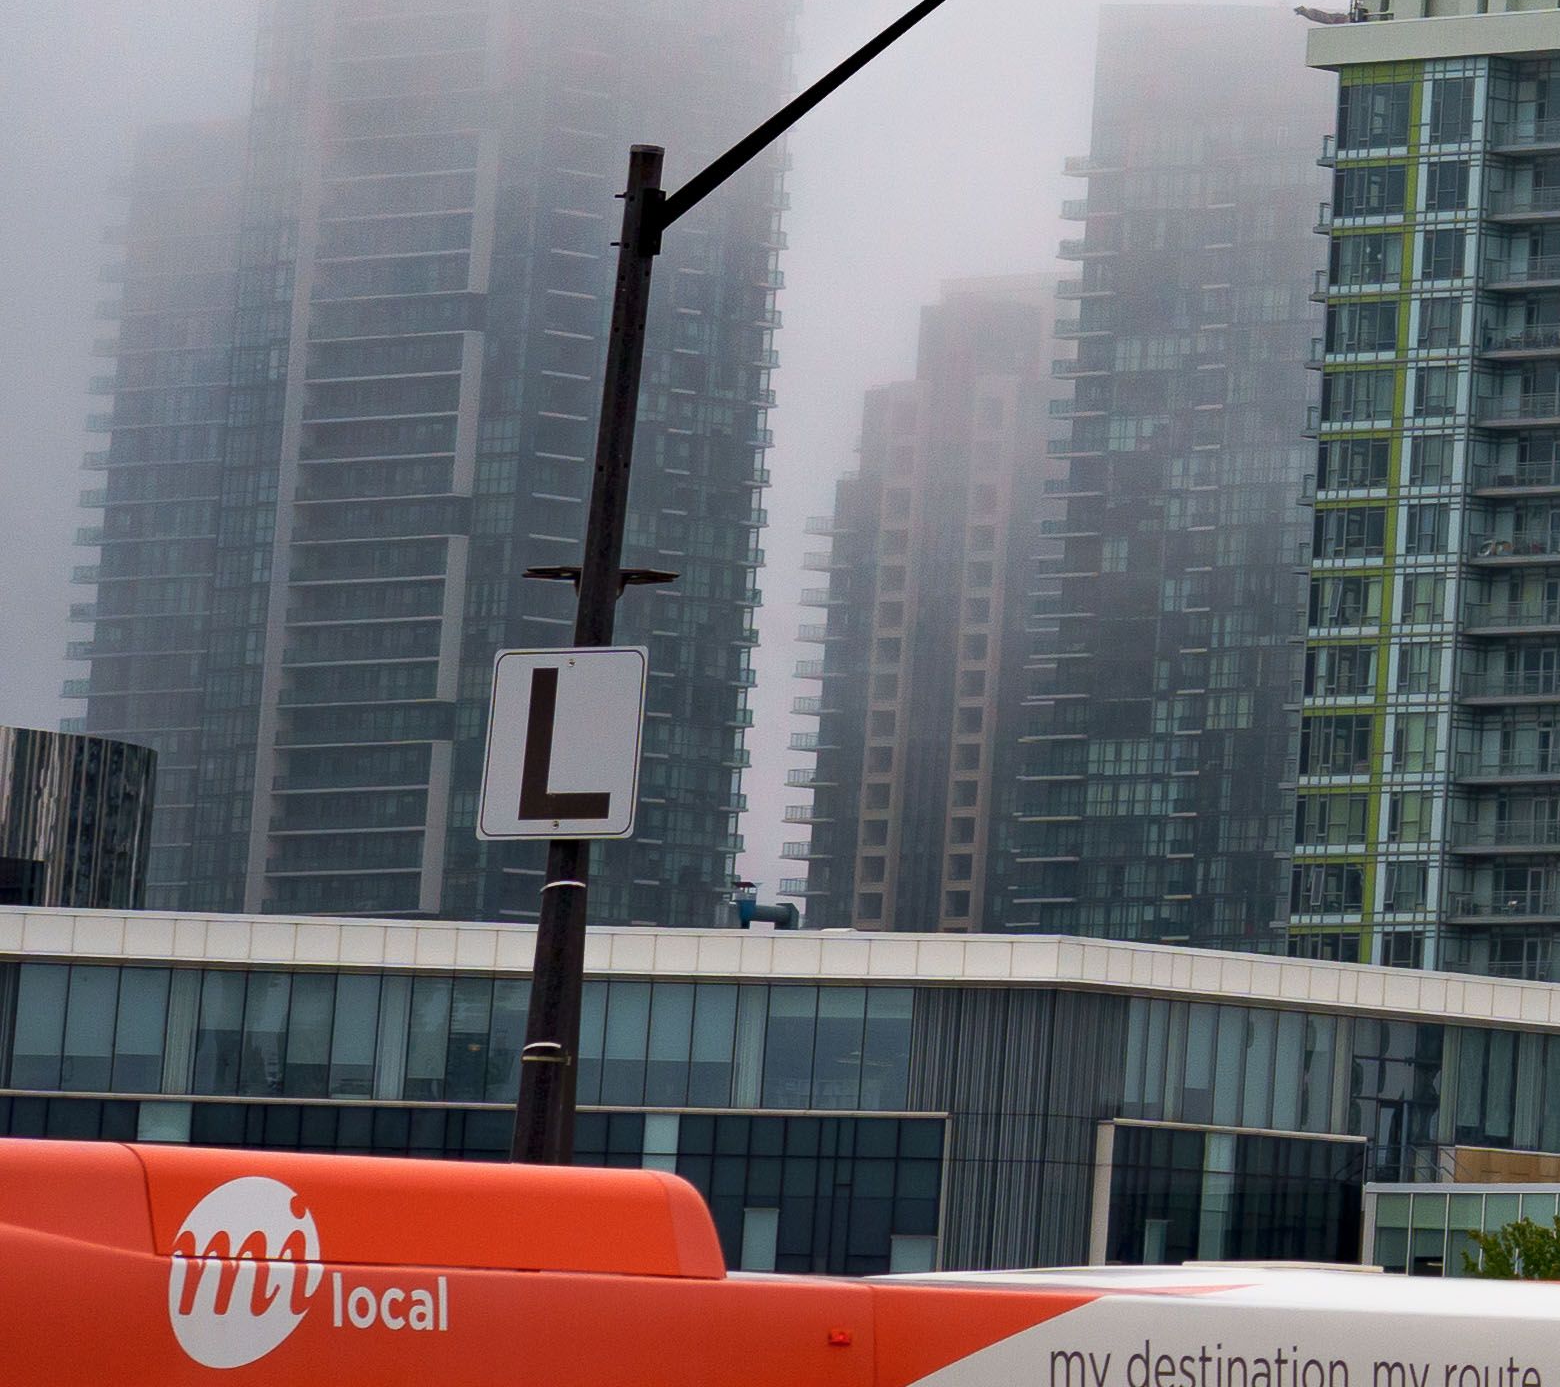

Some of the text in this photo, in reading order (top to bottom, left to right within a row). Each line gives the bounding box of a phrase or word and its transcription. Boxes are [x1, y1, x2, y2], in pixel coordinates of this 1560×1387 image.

[518, 667, 611, 820] L
[332, 1271, 448, 1331] local
[1050, 1350, 1112, 1387] my
[1126, 1339, 1349, 1387] destination
